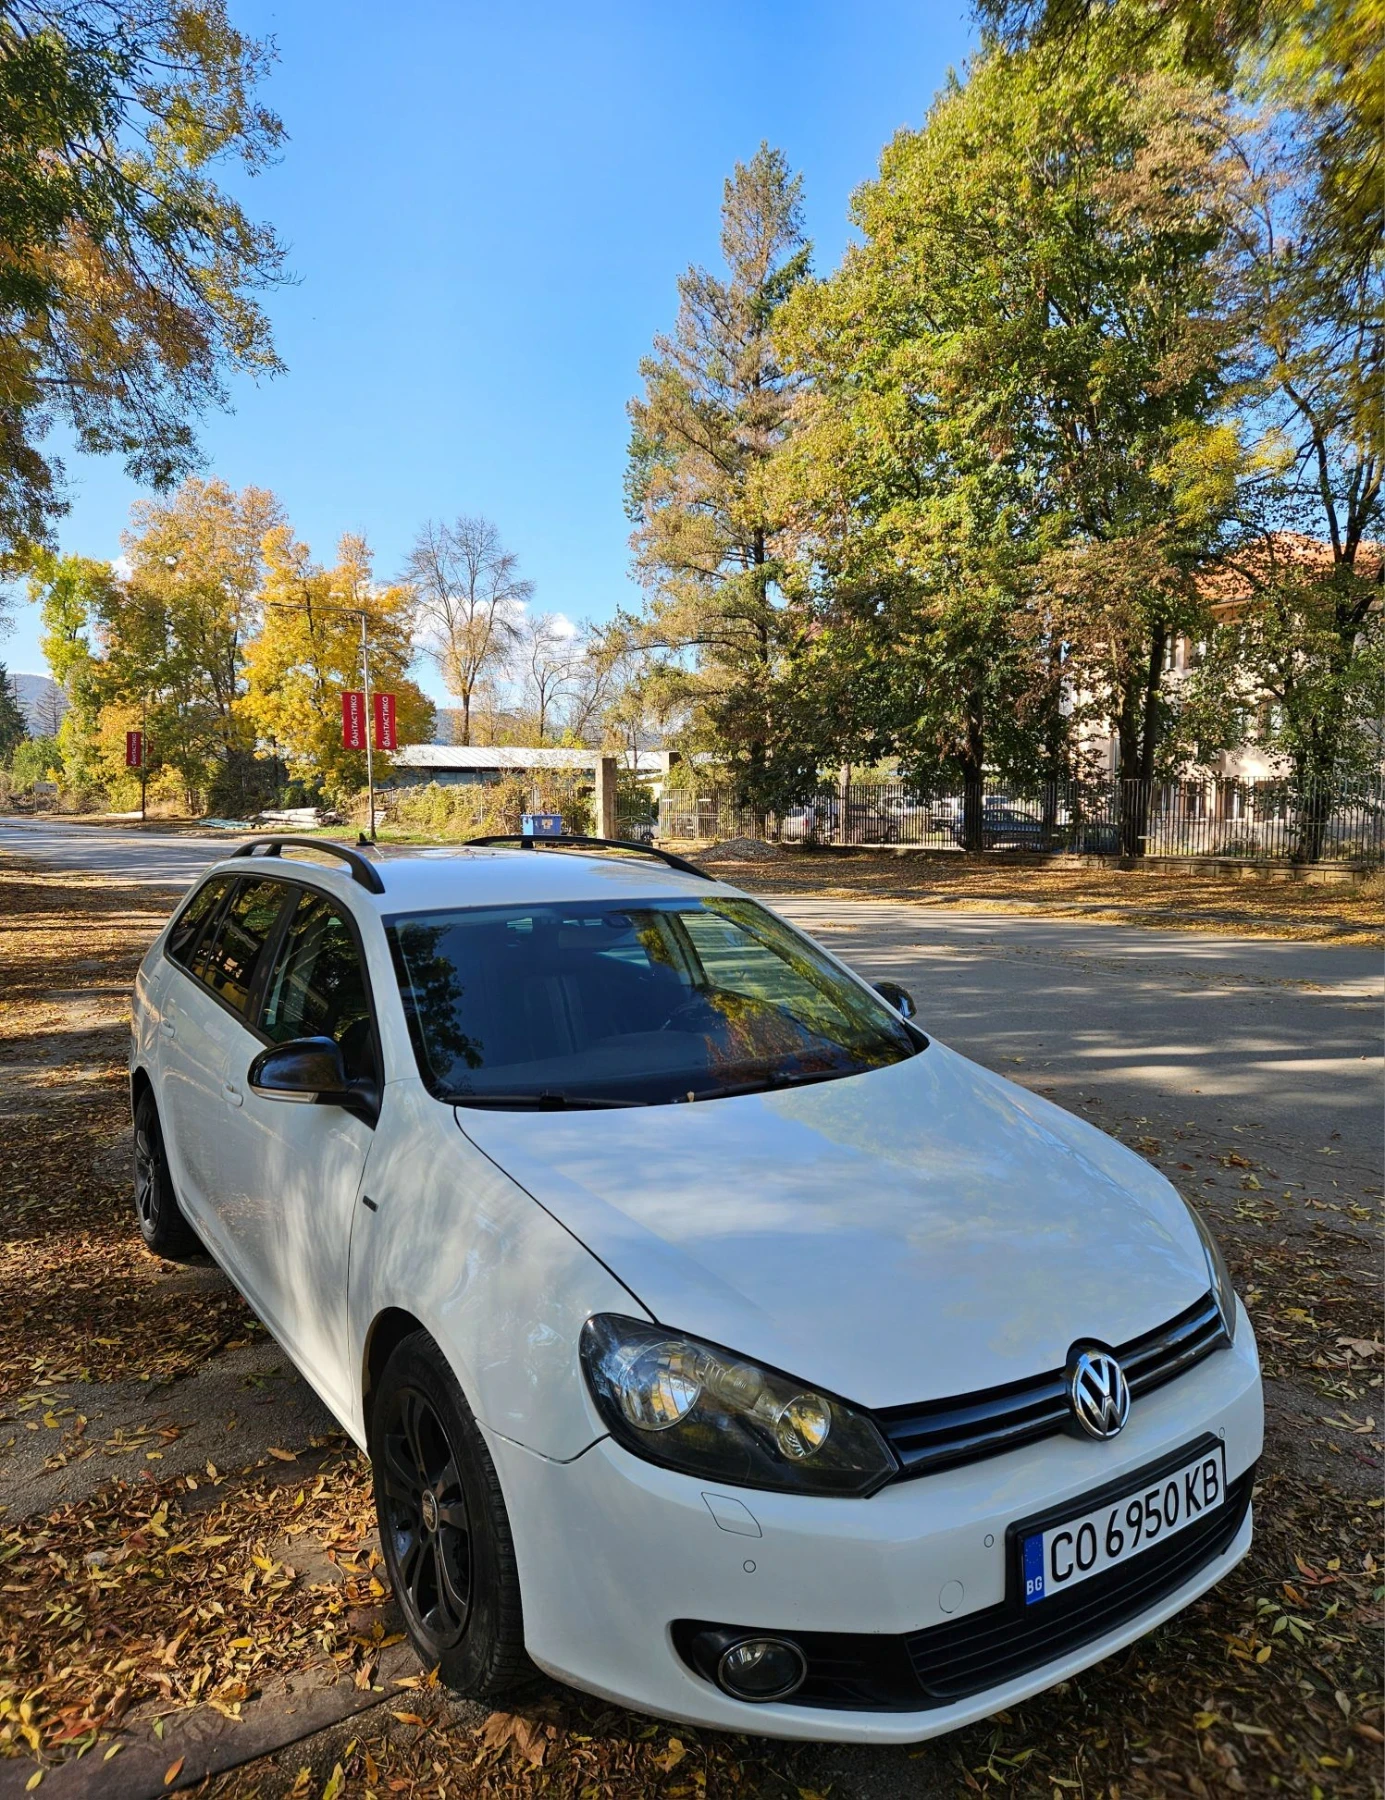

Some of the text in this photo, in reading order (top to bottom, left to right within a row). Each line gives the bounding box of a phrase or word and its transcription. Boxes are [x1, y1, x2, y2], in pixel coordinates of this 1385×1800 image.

[350, 694, 359, 747] ФАНТАСТИКО
[382, 696, 391, 747] ФАНТАСТИКО
[1051, 1458, 1219, 1582] CO 6950 KB
[1026, 1576, 1043, 1595] BG
